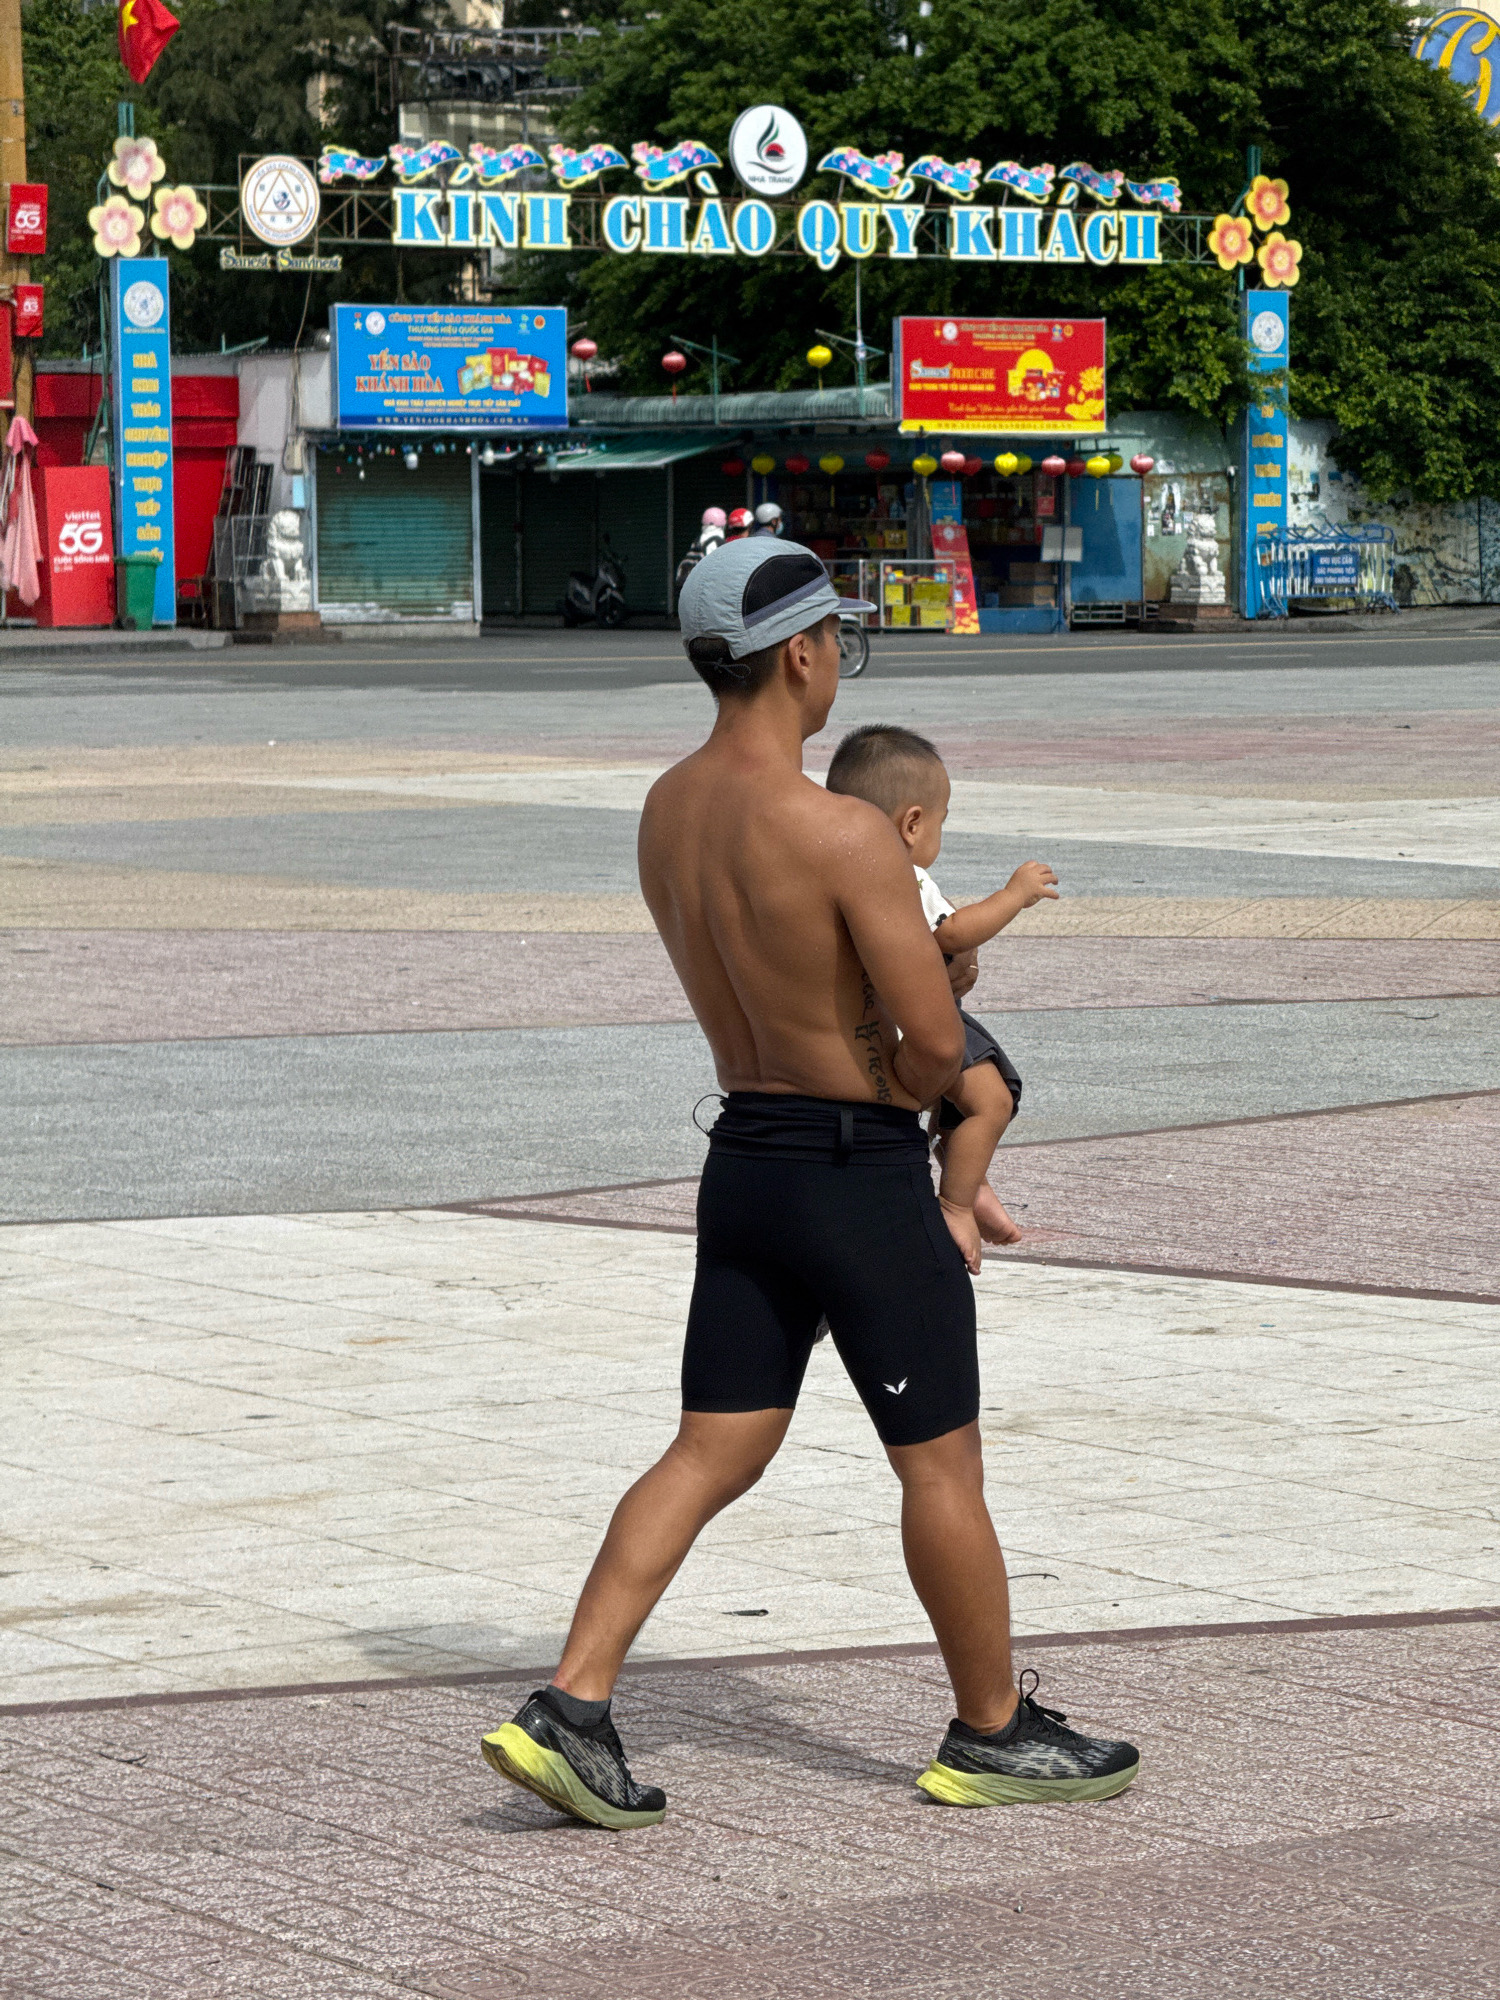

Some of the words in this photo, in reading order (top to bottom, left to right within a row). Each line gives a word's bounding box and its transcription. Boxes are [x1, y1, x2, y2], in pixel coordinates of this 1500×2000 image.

[768, 176, 795, 184] TRANG
[391, 161, 572, 249] KÍNH
[603, 171, 777, 257] CHÀO
[797, 177, 924, 271] QUÝ
[949, 183, 1163, 265] KHÁCH
[220, 246, 271, 270] Sanest
[481, 326, 494, 334] GIA
[133, 351, 157, 368] NHÀ
[368, 347, 399, 371] YẾN
[402, 350, 431, 371] SÀO
[910, 358, 952, 380] Sanest
[355, 371, 410, 392] KHÁNH
[411, 372, 444, 392] HÒA
[65, 510, 100, 521] viettel
[59, 522, 103, 554] 5G
